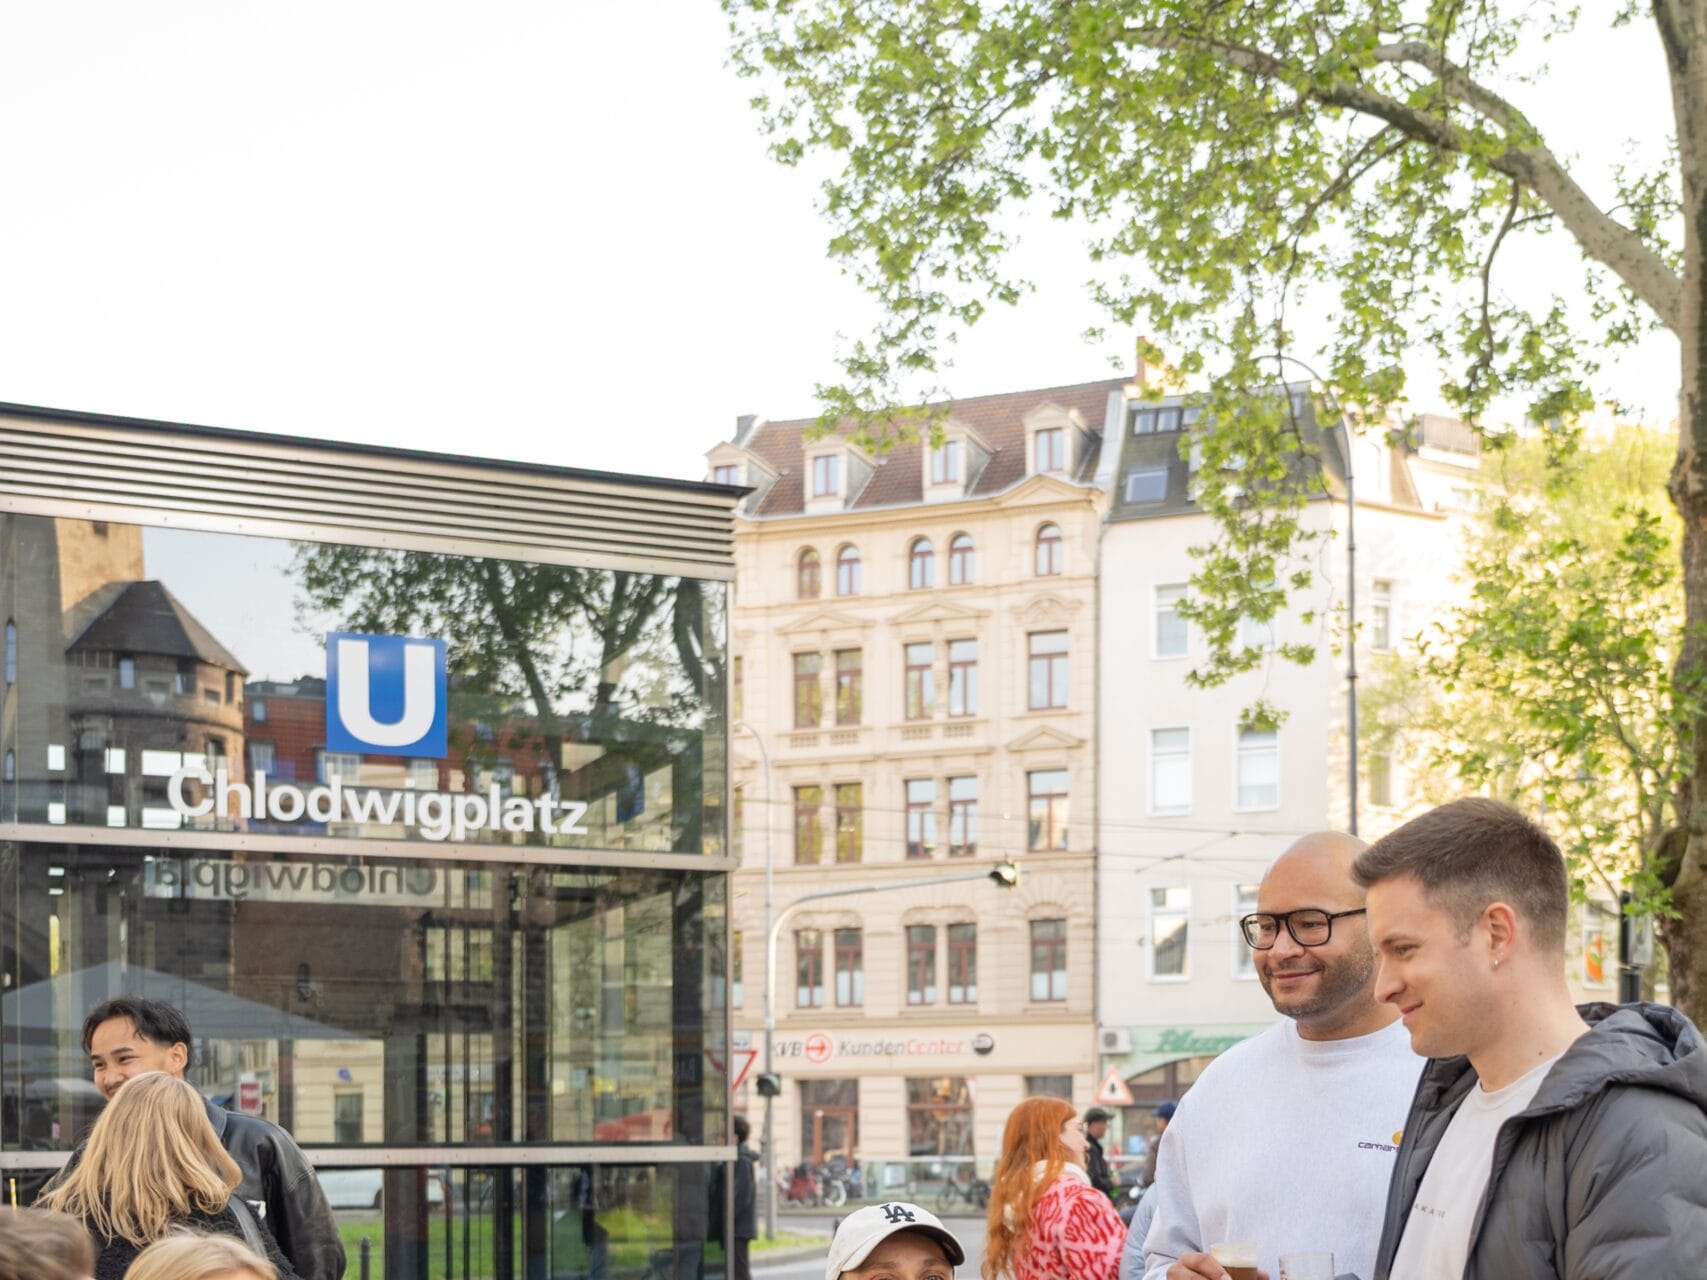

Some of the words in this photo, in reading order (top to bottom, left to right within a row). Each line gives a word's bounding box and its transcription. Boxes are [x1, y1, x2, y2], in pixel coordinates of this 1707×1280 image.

[338, 639, 436, 747] U
[167, 766, 588, 842] Chlodwigplatz
[880, 1203, 916, 1223] LA
